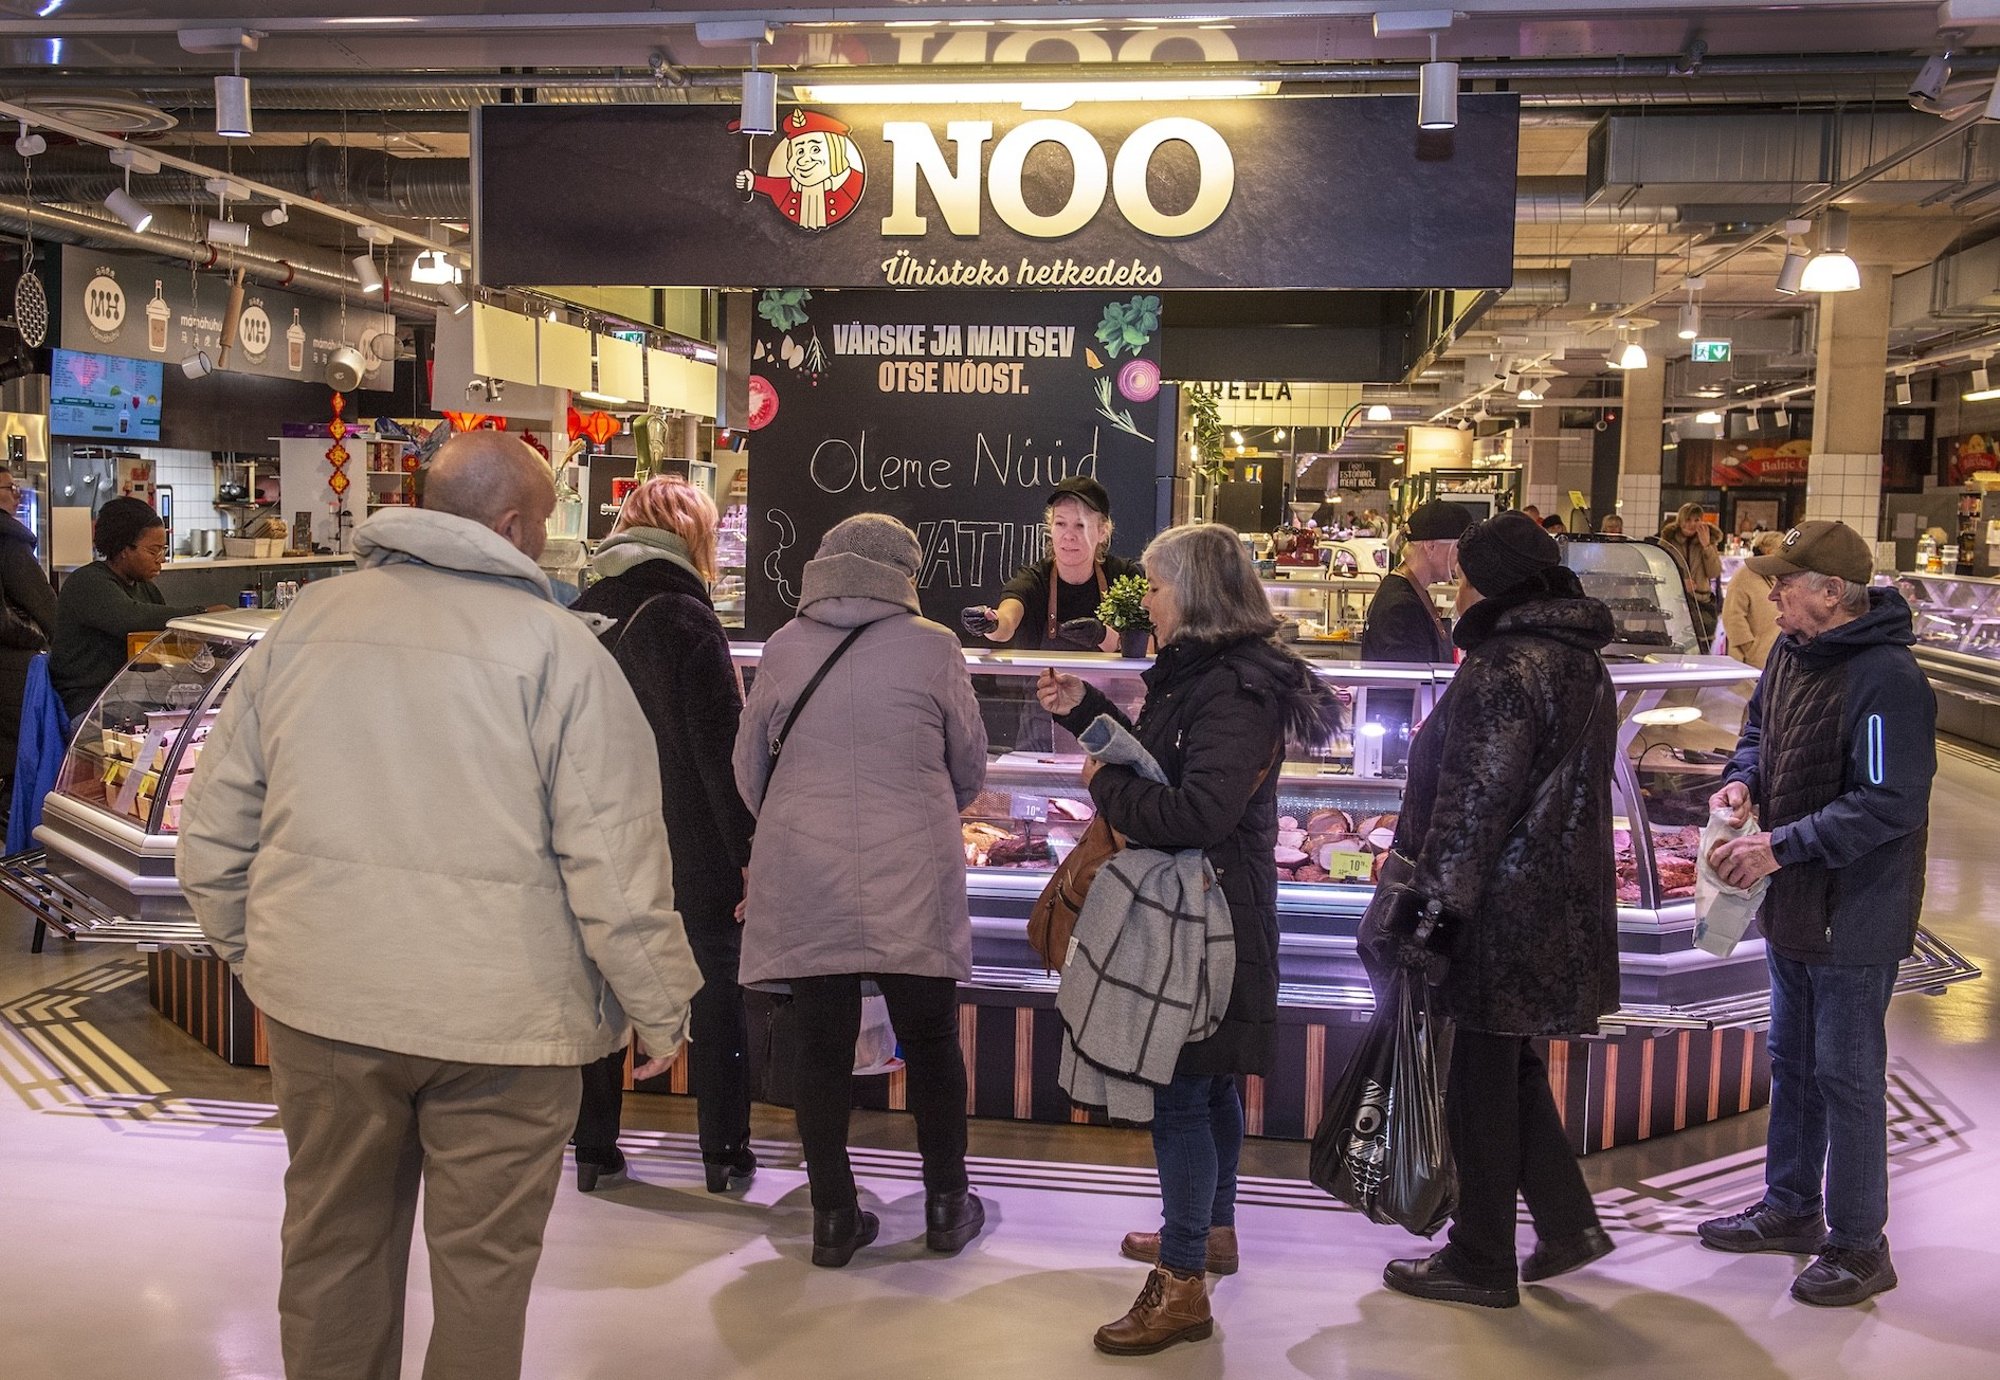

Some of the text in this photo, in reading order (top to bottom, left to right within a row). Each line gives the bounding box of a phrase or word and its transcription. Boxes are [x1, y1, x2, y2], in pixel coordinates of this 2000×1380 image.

[881, 250, 1163, 286] Ühisteks hetkedeks
[833, 321, 1075, 357] VÄRSKE JA MAITSEV
[878, 359, 1030, 394] OTSE NÕOST.
[810, 430, 951, 493] Oleme
[1340, 470, 1372, 478] ESTONIAN
[1761, 457, 1795, 472] Baltic
[1340, 478, 1376, 487] MEAT HOUSE
